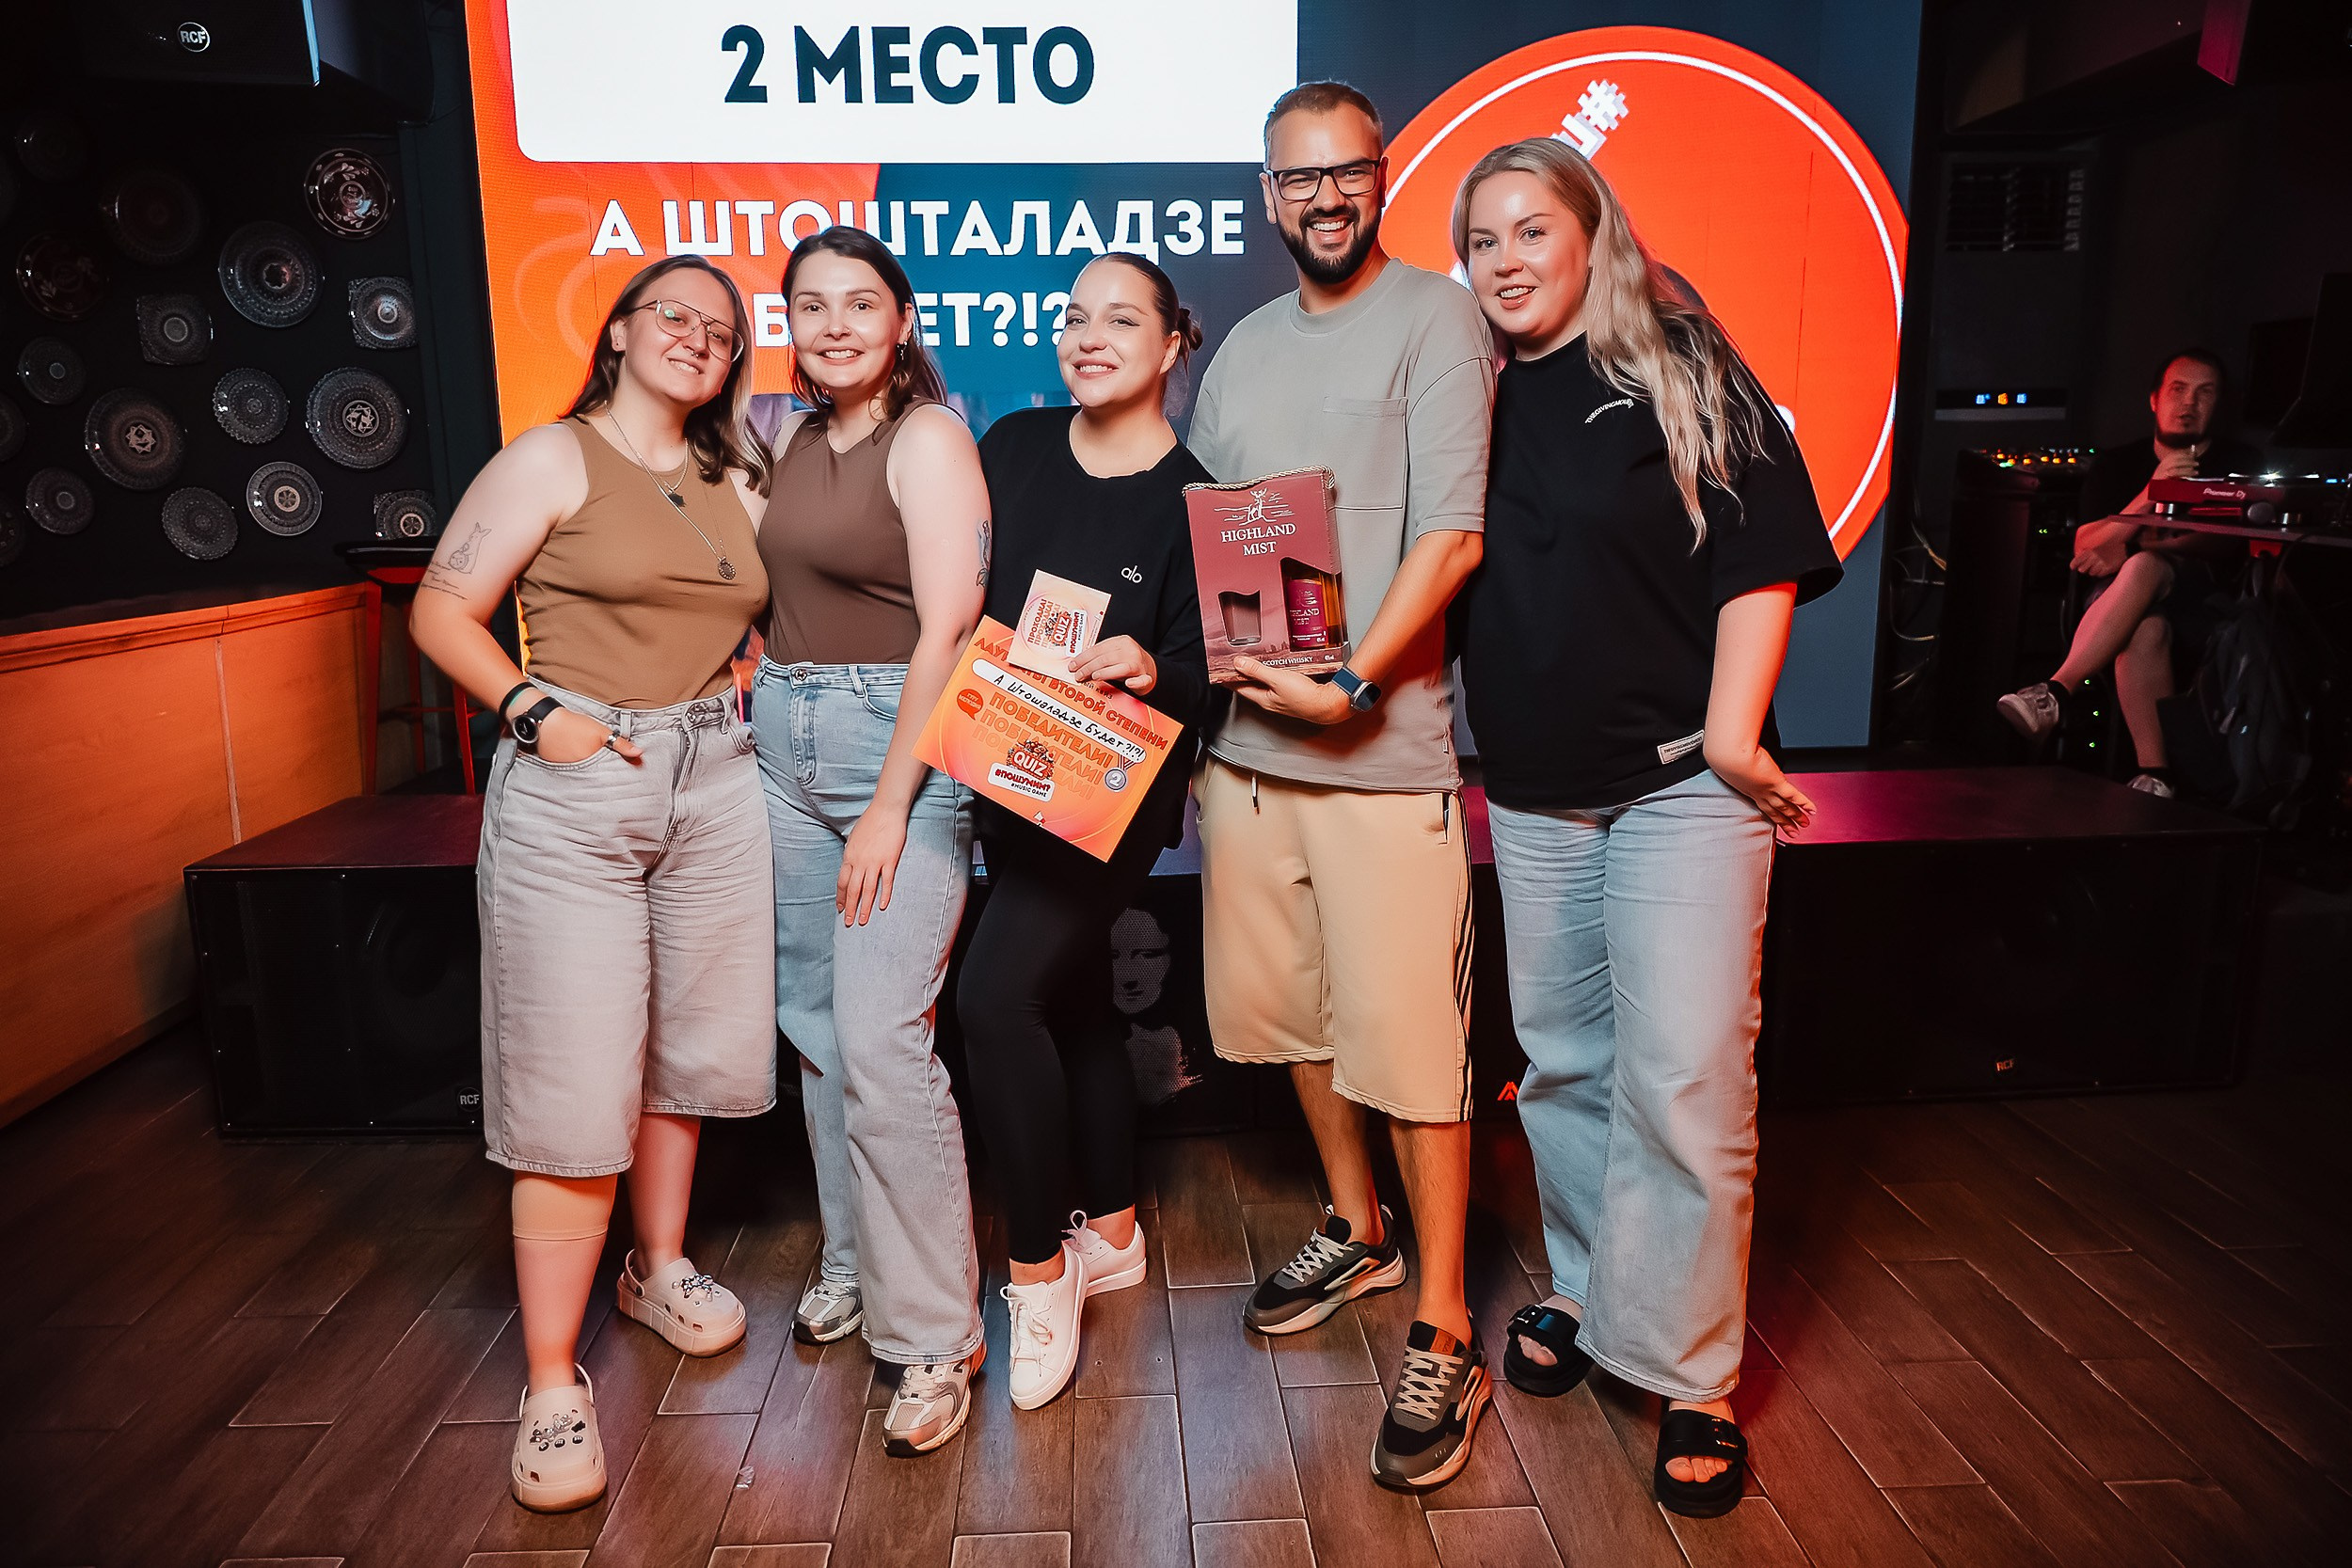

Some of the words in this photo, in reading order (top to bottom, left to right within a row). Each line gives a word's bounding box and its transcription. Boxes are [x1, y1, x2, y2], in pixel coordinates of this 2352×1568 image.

[180, 30, 206, 44] RCF
[722, 24, 768, 103] 2
[794, 24, 1094, 104] МЕСТО
[589, 199, 645, 257] А
[1220, 523, 1296, 543] HIGHLAND
[1243, 541, 1277, 556] MIST
[1053, 616, 1070, 642] QUIZ
[993, 673, 1005, 686] А
[1048, 678, 1107, 716] ВТОРОЙ
[1106, 710, 1168, 751] СТЕПЕНИ
[1013, 751, 1048, 777] QUIZ
[1109, 774, 1122, 787] 2
[460, 1094, 480, 1104] RCF
